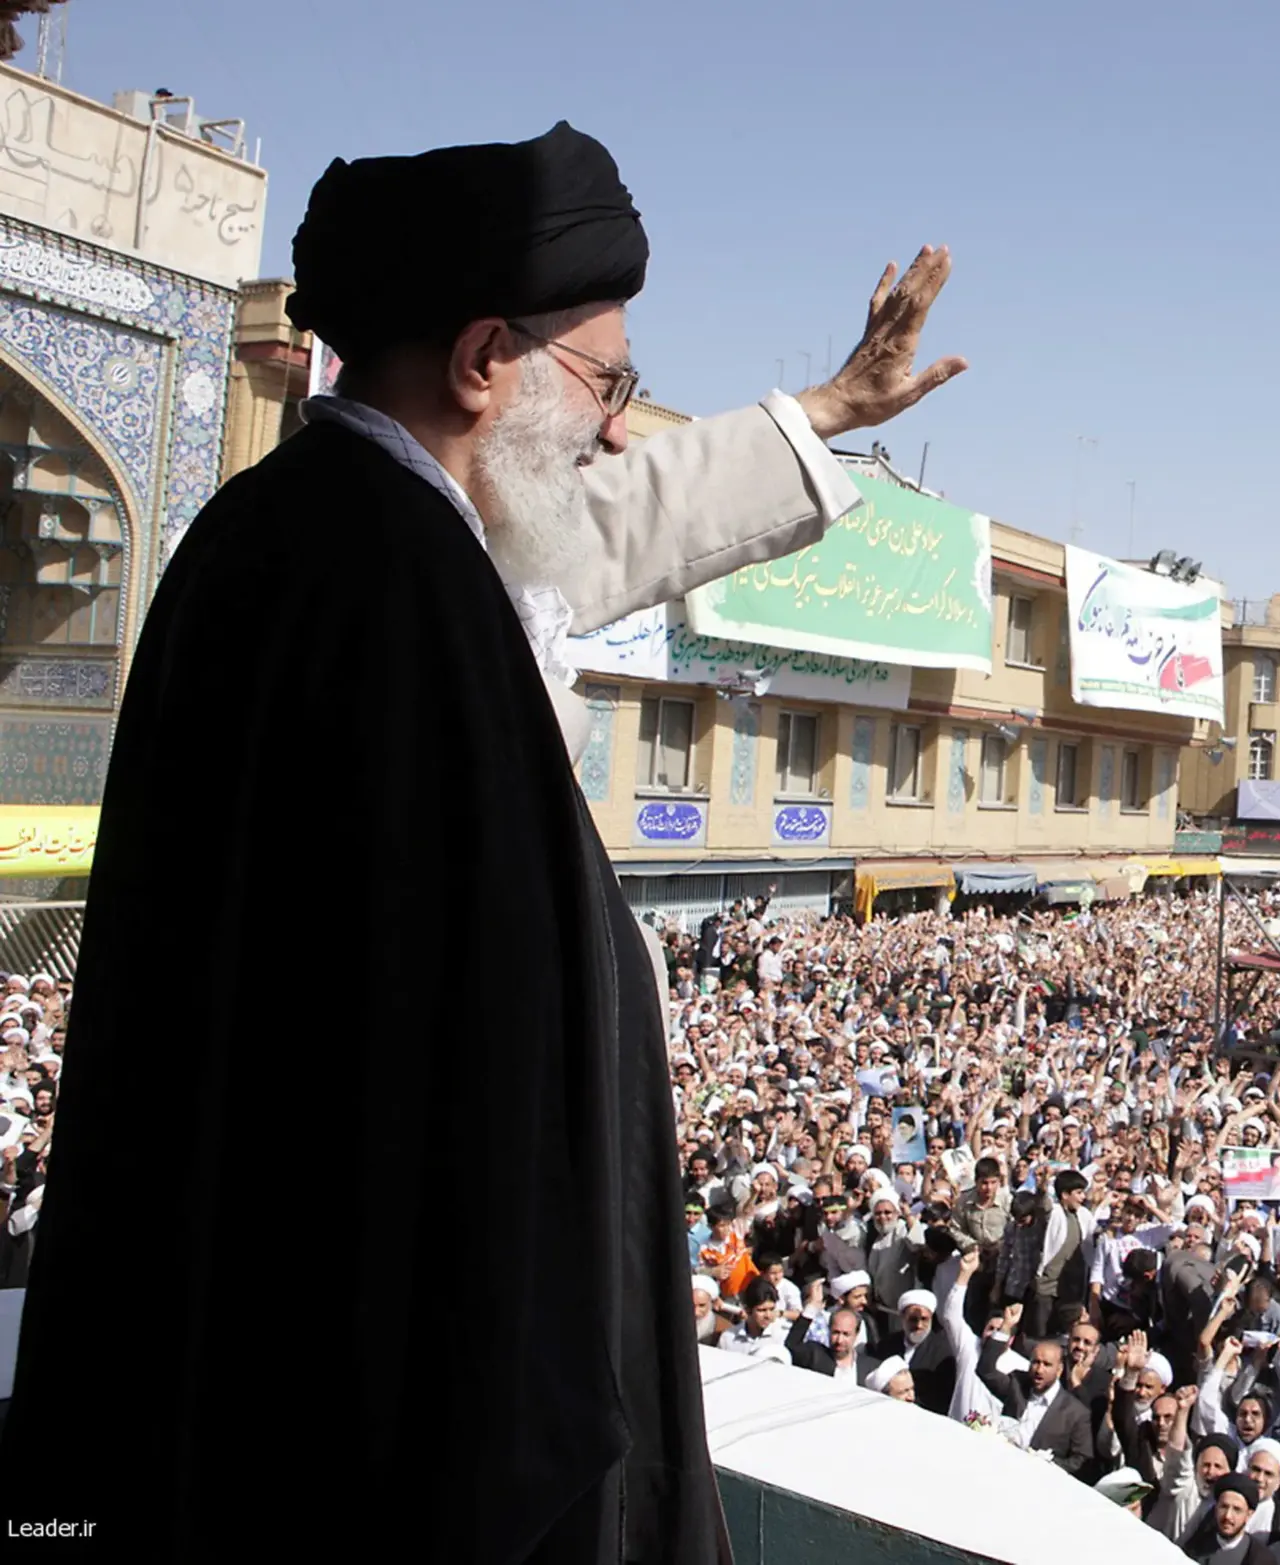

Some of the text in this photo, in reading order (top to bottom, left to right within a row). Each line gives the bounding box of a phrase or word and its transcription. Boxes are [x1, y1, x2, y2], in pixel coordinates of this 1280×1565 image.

[217, 199, 258, 246] بسیج
[867, 518, 893, 547] موسی
[903, 519, 923, 556] علی
[770, 545, 819, 609] تبریک
[814, 563, 862, 607] انقلاب
